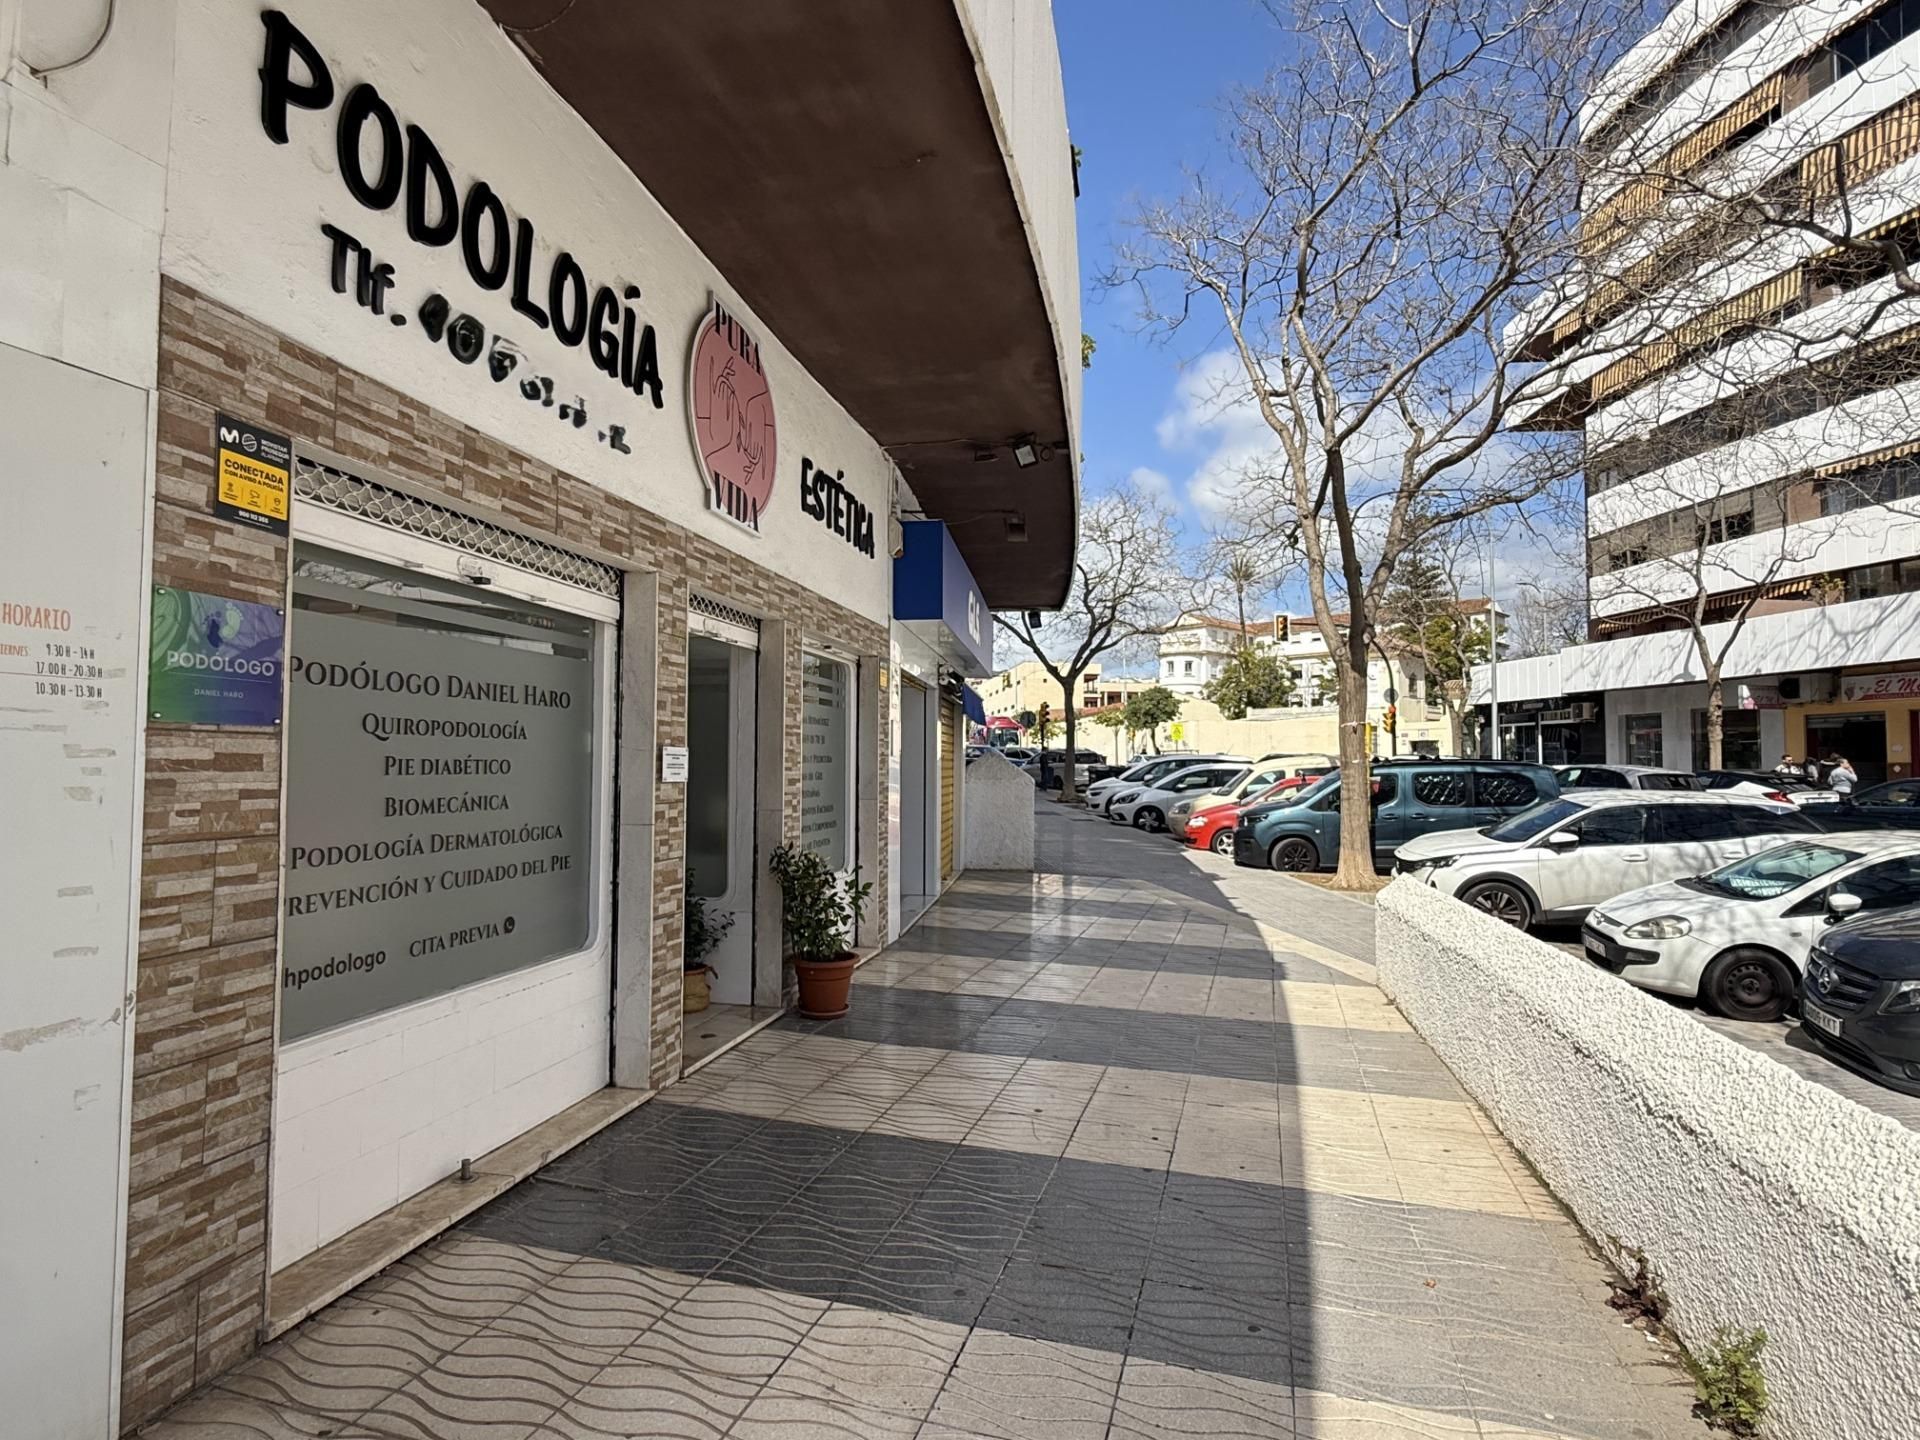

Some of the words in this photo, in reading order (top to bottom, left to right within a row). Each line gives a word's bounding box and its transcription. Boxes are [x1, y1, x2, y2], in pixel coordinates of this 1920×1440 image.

[258, 9, 664, 409] PODOLOGÍA
[321, 222, 408, 327] Tlf.
[714, 299, 762, 376] PURA
[224, 458, 284, 486] CONECTADA
[224, 469, 238, 478] CON
[239, 474, 257, 484] AVISO
[713, 470, 760, 533] VIDA
[800, 455, 875, 560] ESTÉTICA
[2, 602, 71, 632] HORARIO
[65, 646, 71, 658] H
[167, 650, 275, 677] PODÓLOGO
[194, 688, 221, 697] DANIEL
[289, 655, 440, 696] PODÓLOGO
[447, 674, 519, 704] DANIEL
[524, 684, 571, 710] HARO
[361, 712, 528, 742] QUIROPODOLOGÍA
[384, 755, 414, 776] PIE
[420, 754, 511, 776] DIABÉTICO
[384, 792, 510, 818] BIOMECÁNICA
[290, 833, 425, 870] PODOLOGÍA
[430, 823, 563, 853] DERMATOLÓGICA
[284, 875, 418, 917] REVENCIÓN
[424, 876, 436, 893] Y
[440, 864, 518, 891] CUIDADO
[522, 857, 549, 878] DEL
[550, 854, 572, 873] PIE
[284, 950, 386, 990] hpodologo
[409, 936, 446, 958] CITA
[449, 921, 500, 948] PREVIA
